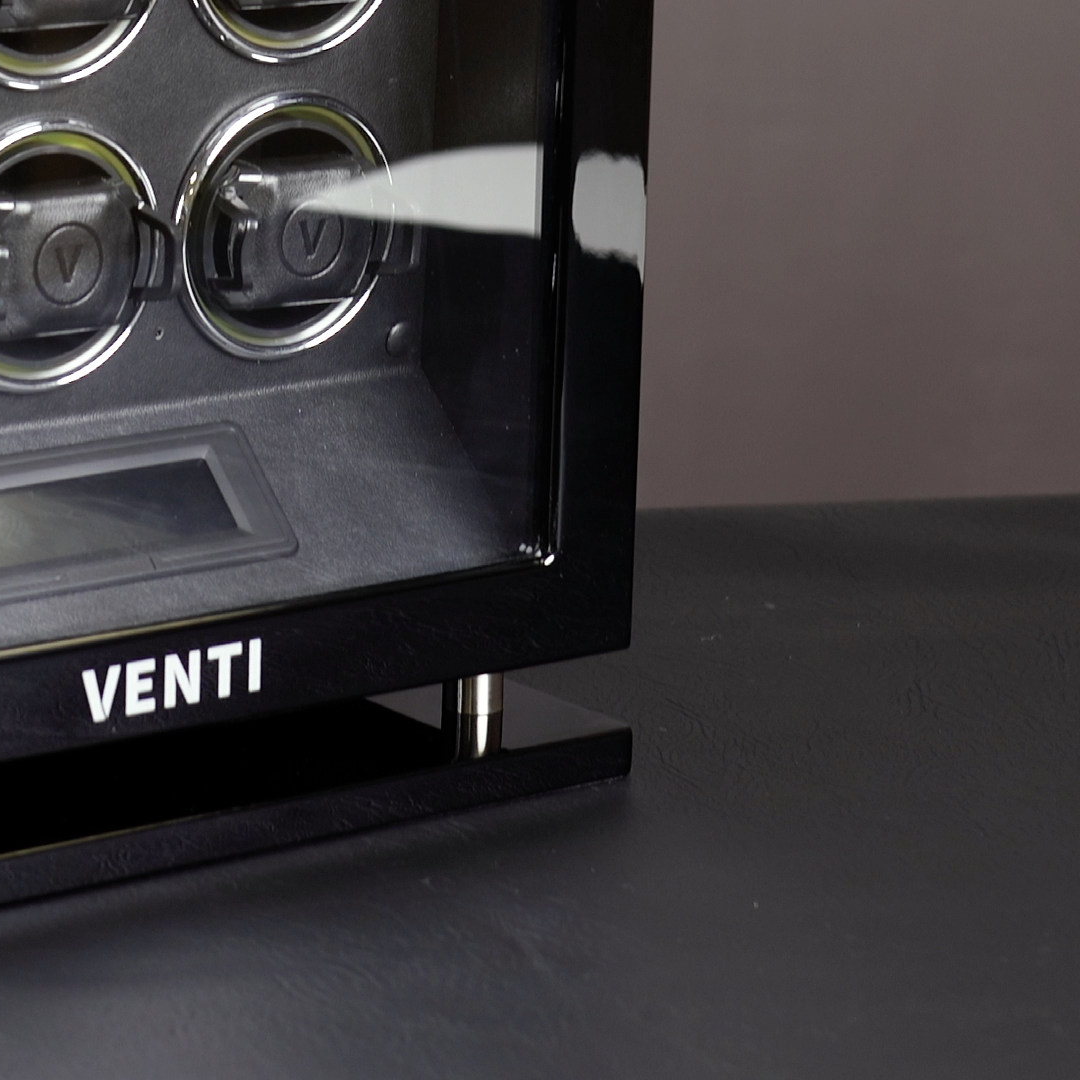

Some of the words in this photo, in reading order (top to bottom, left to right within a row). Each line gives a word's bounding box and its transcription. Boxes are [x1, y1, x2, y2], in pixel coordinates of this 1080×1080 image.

[299, 219, 326, 258] V
[55, 243, 83, 283] V
[81, 637, 262, 723] VENTI
